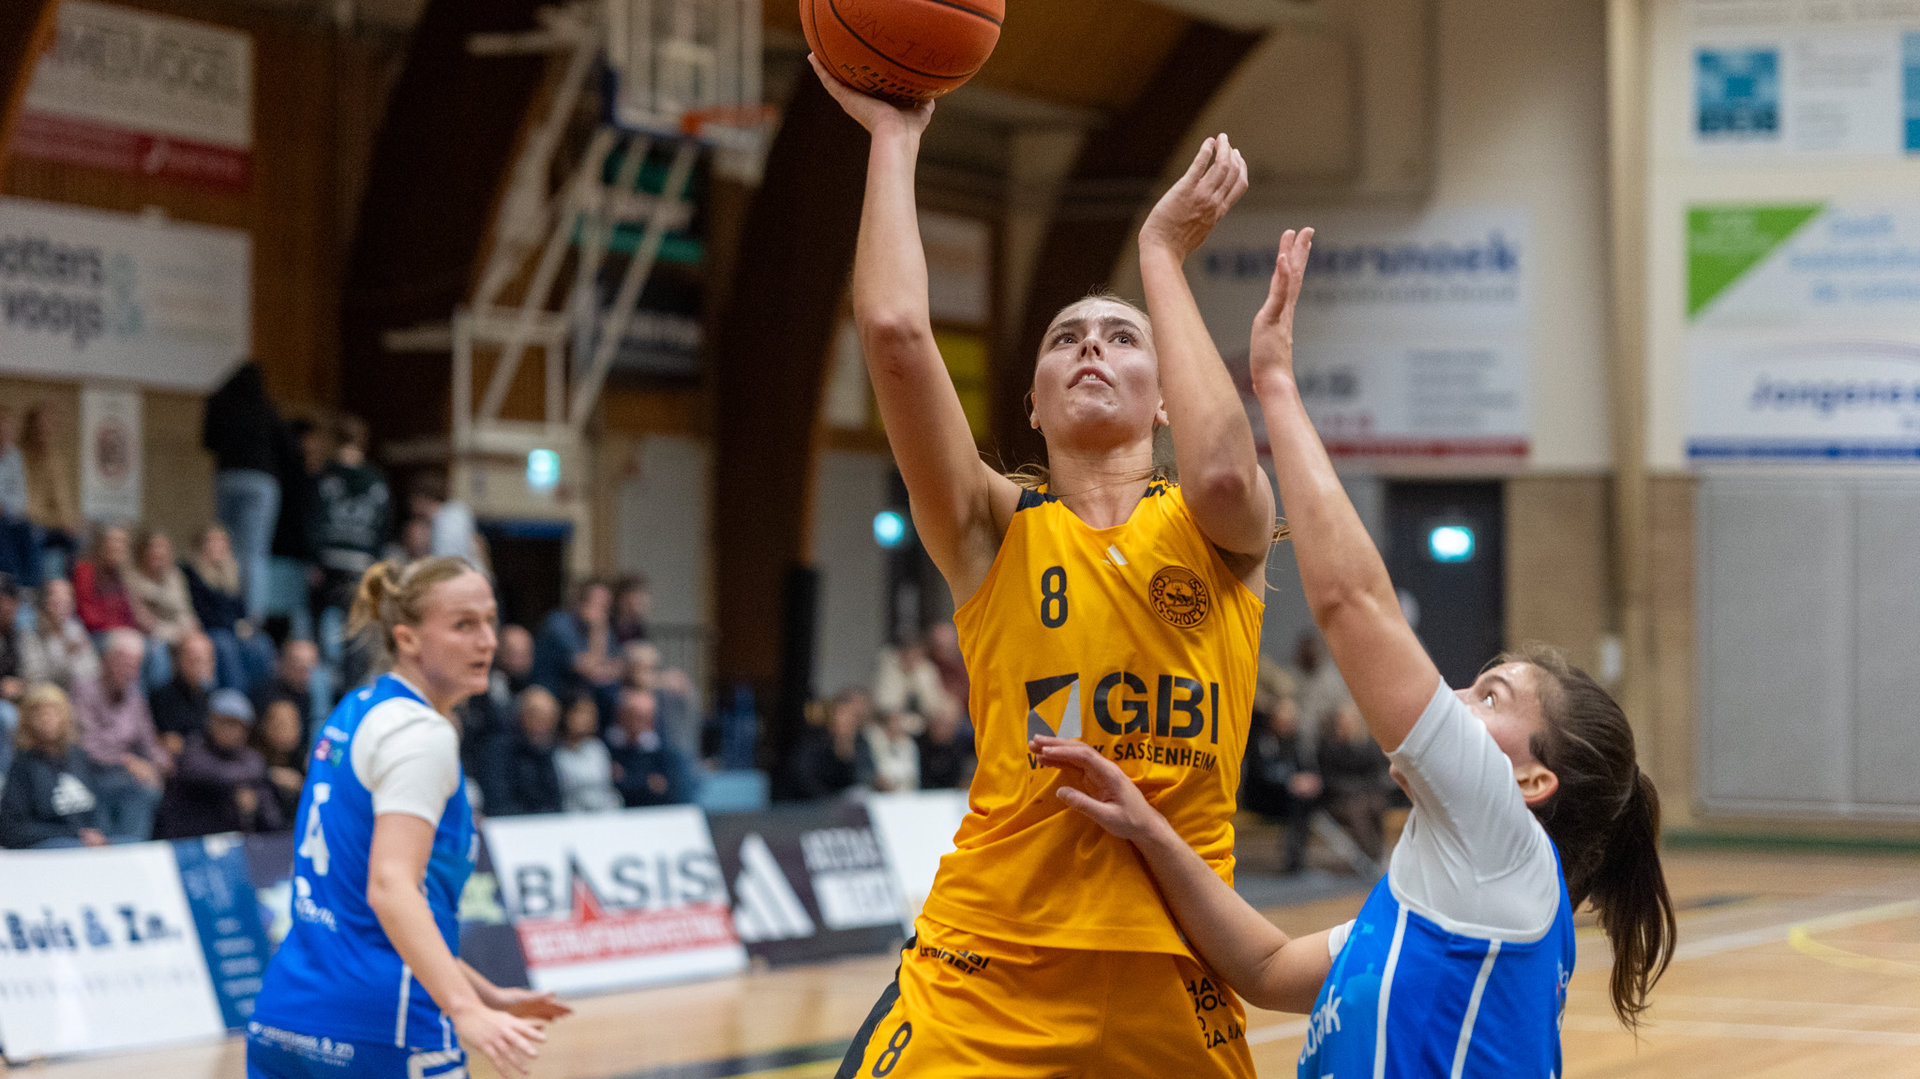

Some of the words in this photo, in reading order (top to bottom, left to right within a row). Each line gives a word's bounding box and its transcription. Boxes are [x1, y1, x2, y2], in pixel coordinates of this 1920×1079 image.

[1041, 565, 1069, 628] 8
[1093, 671, 1219, 745] GBI
[1114, 742, 1217, 772] SASSENHEIM
[515, 846, 722, 918] BASIS
[919, 944, 981, 974] trainer
[872, 1021, 912, 1078] 8
